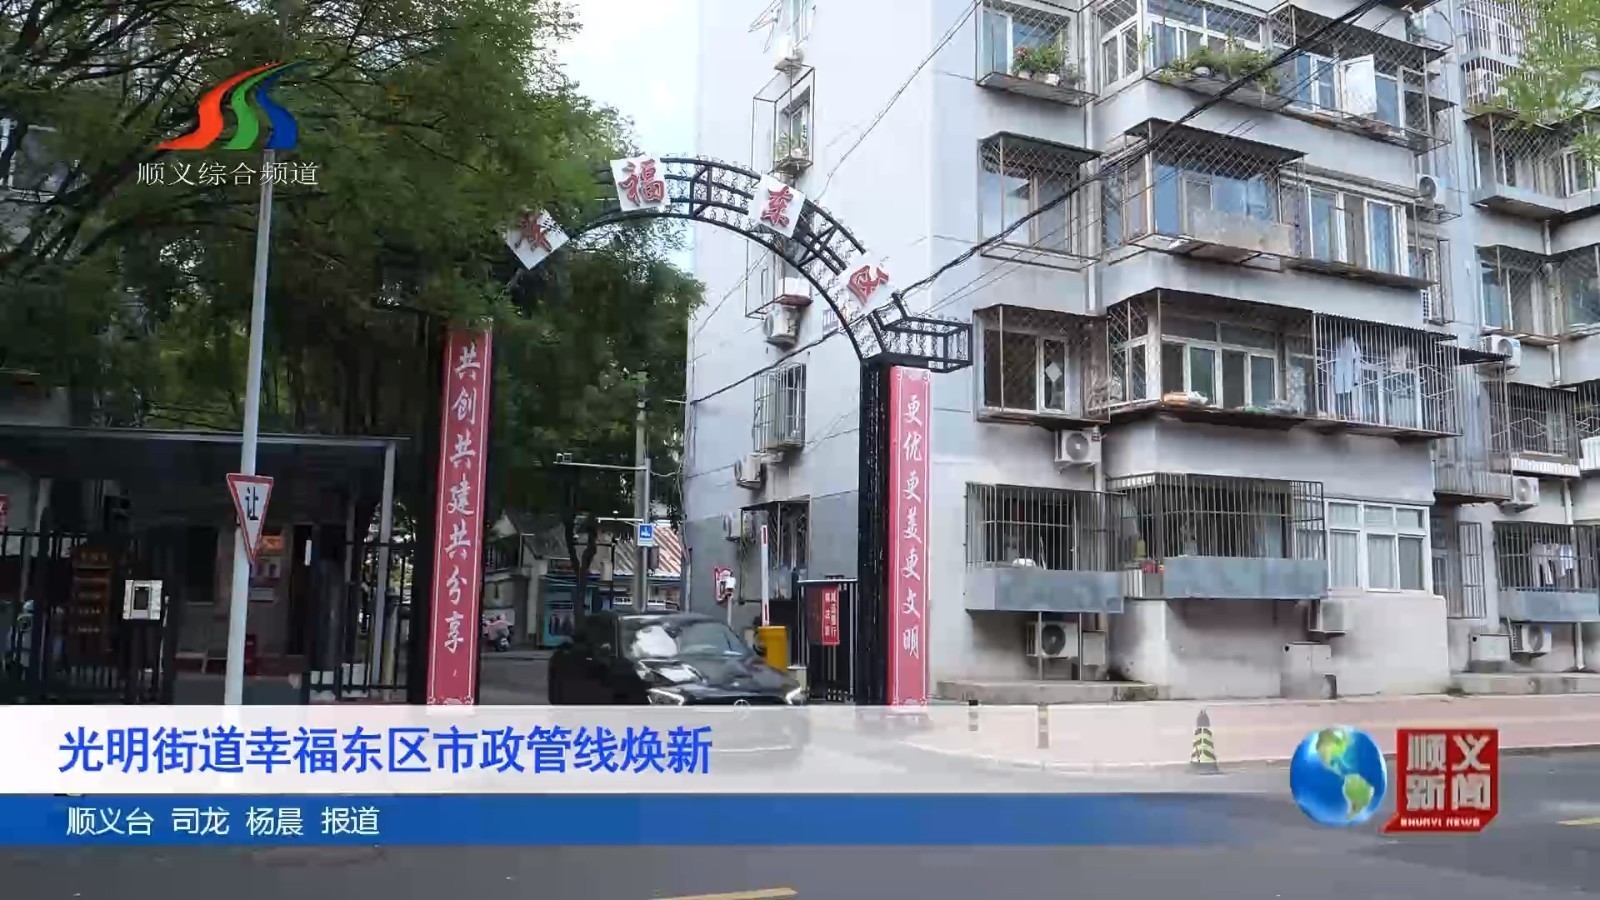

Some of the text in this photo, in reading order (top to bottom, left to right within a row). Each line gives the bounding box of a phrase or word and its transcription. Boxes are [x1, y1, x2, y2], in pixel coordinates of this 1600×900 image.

[244, 486, 259, 521] 让
[901, 394, 923, 659] 更优更美更文明
